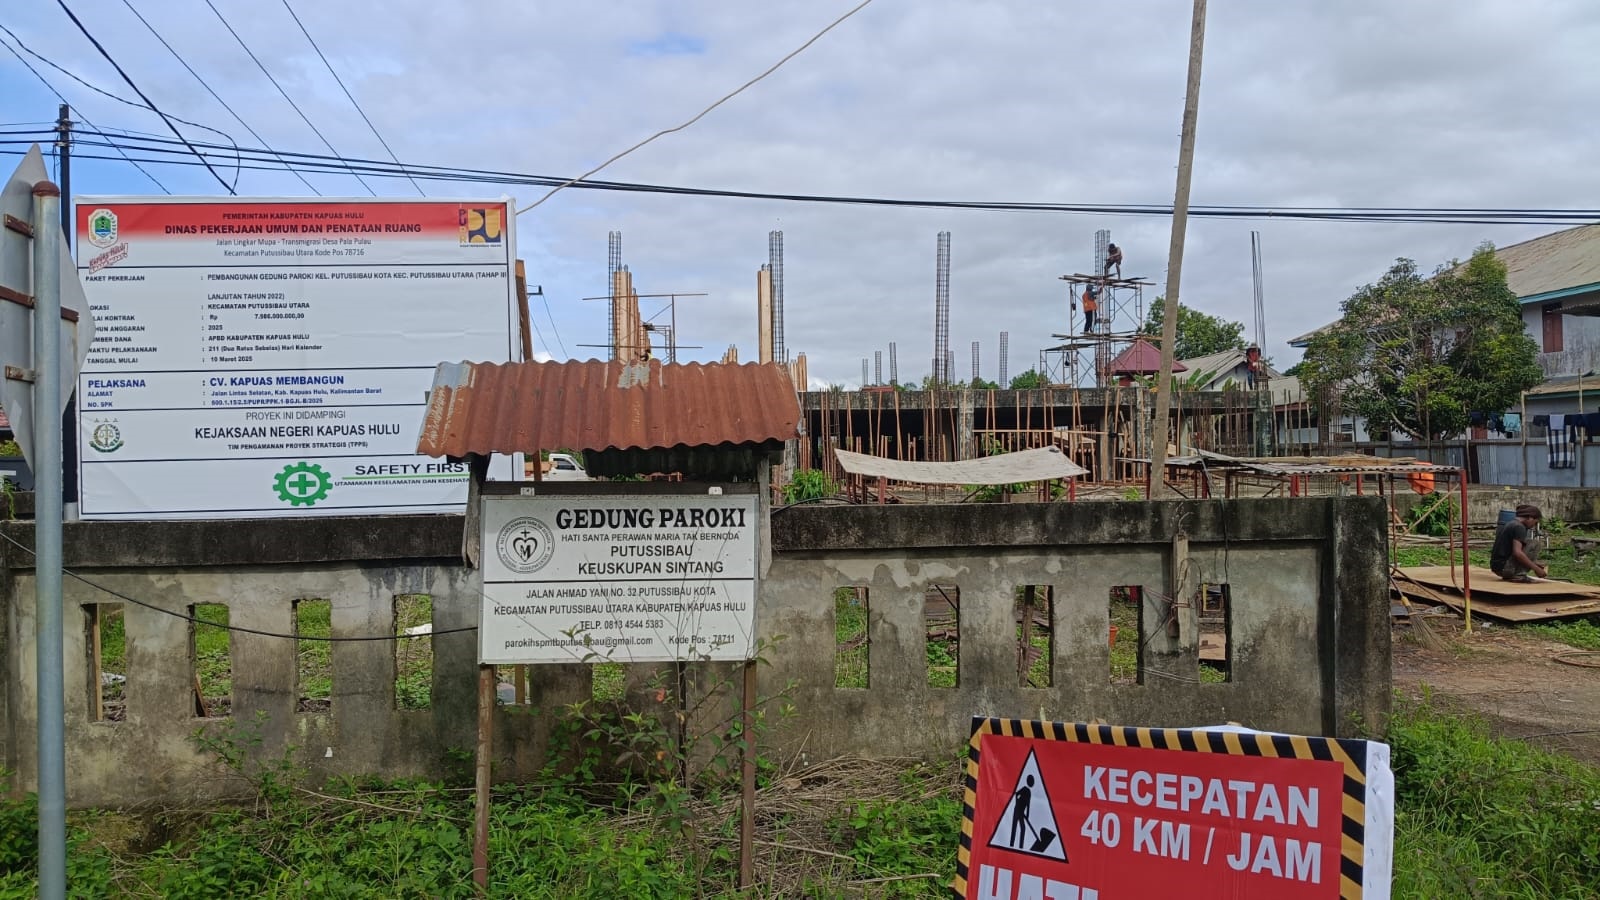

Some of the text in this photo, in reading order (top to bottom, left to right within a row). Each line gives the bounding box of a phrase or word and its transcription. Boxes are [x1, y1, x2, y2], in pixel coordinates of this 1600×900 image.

[165, 223, 421, 234] DINAS PEKERJAAN UMUM DAN PENATAAN RUANG
[216, 238, 232, 246] Jalan
[234, 238, 256, 248] Lingkar
[281, 237, 321, 247] Transmigrasi
[323, 237, 338, 245] Desa
[354, 237, 372, 245] Pulau
[224, 249, 258, 257] Kecamatan
[260, 249, 294, 257] Putussibau
[315, 248, 330, 256] Kode
[331, 248, 343, 256] Pos
[345, 248, 364, 256] 78716
[88, 376, 344, 388] PELAKSANA CV. KAPUAS MEMBANGUN
[246, 411, 345, 420] PROYEK INI DIDAMPINGI
[195, 424, 400, 438] KEJAKSAAN NEGERI KAPUAS HULU
[355, 464, 421, 476] SAFETY
[556, 508, 746, 529] GEDUNG PAROKI
[561, 534, 580, 542] HATI
[583, 534, 610, 542] SANTA
[611, 533, 652, 541] PERAWAN
[654, 533, 680, 541] MARIA
[682, 533, 698, 541] TAK
[611, 545, 693, 557] PUTUSSIBAU
[578, 561, 724, 575] KEUSKUPAN SINTANG
[526, 587, 716, 599] JALAN AHMAD YANI NO. 32 PUTUSSIBAU KOTA
[494, 602, 746, 615] KECAMATAN PUTUSSIBAU UTARA KABUPATEN KAPUAS HULU
[580, 619, 664, 630] TELP. 0813 4544 5383
[669, 635, 689, 644] Kode
[691, 635, 706, 644] Pos
[1083, 765, 1319, 828] KECEPATAN
[1081, 810, 1322, 885] 40 KM / JAM
